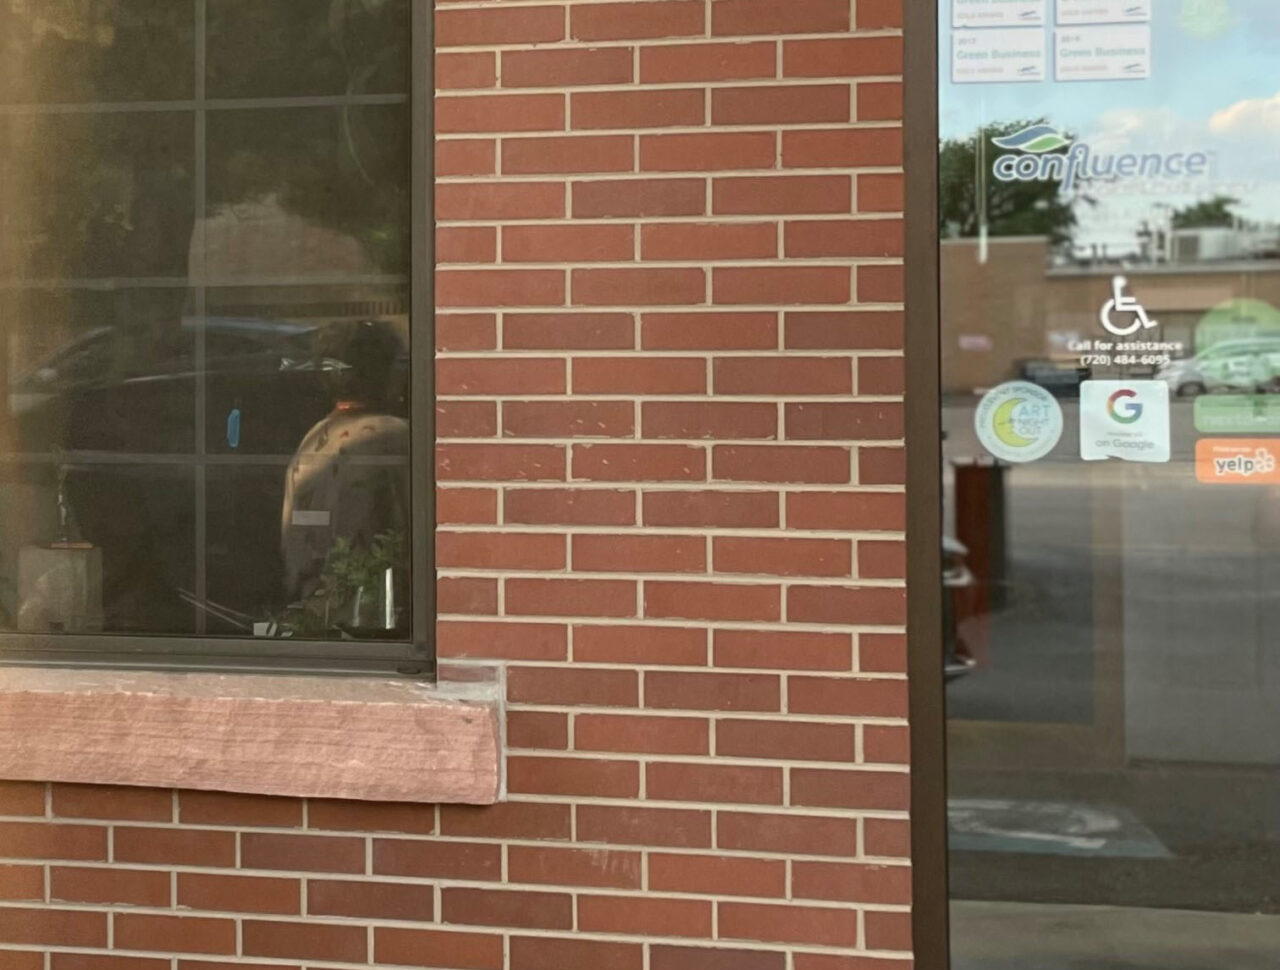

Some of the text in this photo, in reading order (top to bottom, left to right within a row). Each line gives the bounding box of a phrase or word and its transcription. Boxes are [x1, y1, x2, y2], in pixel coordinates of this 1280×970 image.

[956, 49, 1041, 59] Green Business
[1060, 47, 1146, 58] Green Business
[994, 143, 1208, 192] confluence
[1067, 339, 1183, 351] Call for assistance
[1080, 354, 1170, 367] (720) 484-6095
[1018, 405, 1051, 417] ART
[1106, 388, 1143, 425] G
[1019, 425, 1041, 435] OUT
[1095, 438, 1155, 452] on Google
[1215, 457, 1254, 474] yelp
